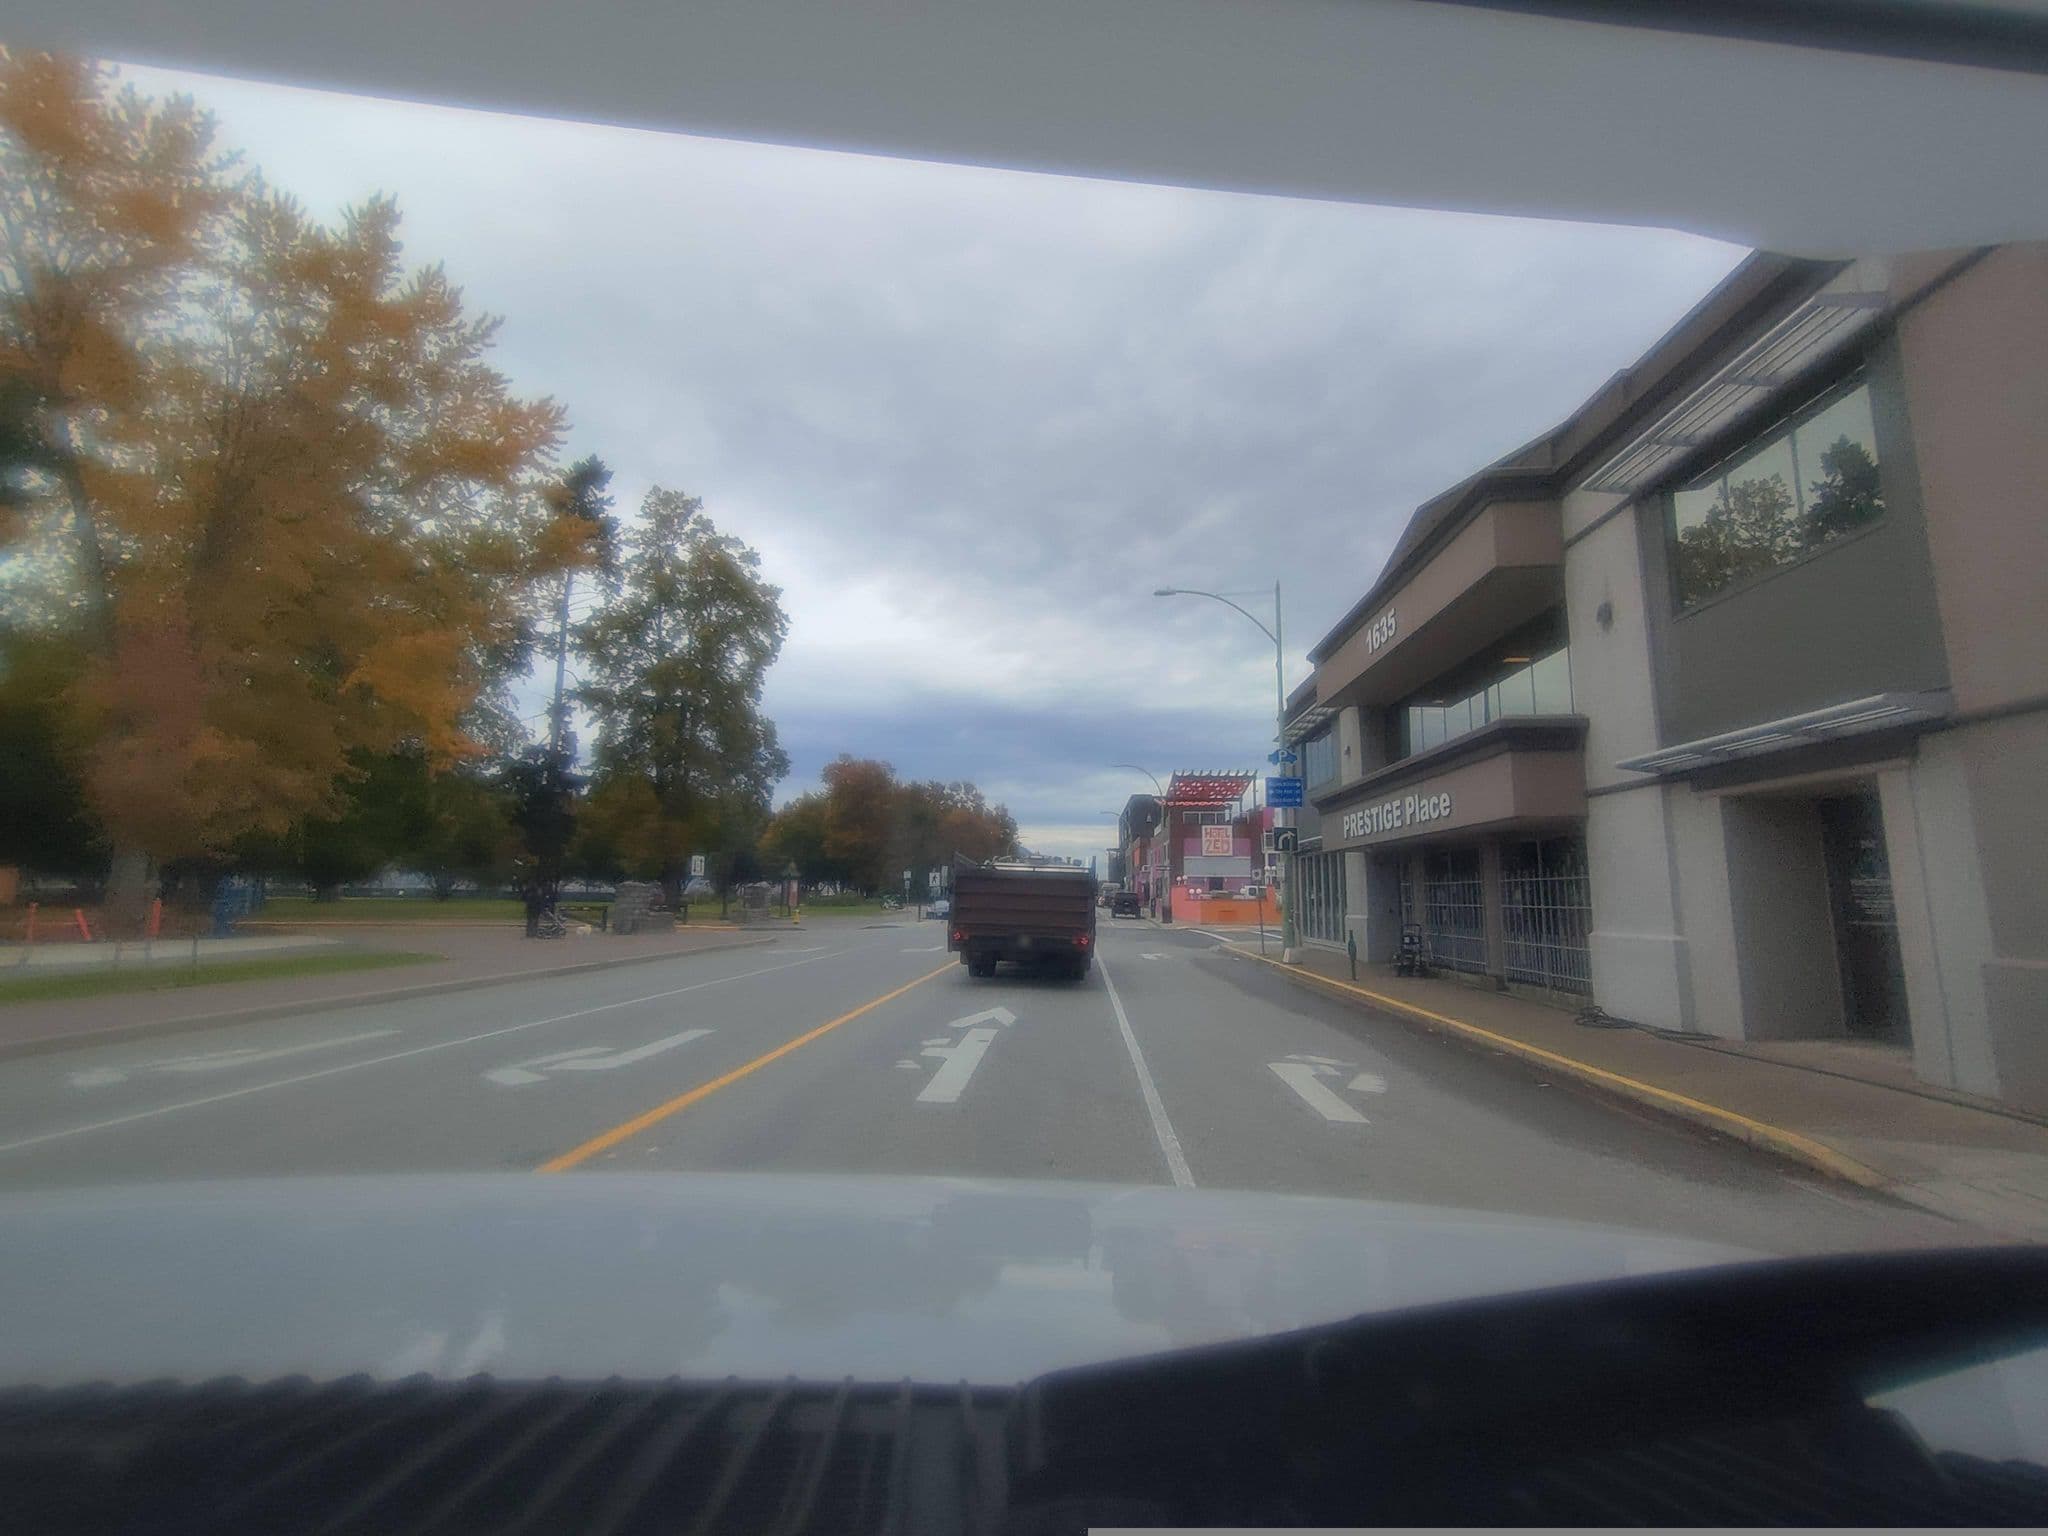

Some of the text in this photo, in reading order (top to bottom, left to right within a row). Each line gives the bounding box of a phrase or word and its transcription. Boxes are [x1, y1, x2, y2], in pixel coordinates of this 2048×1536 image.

[1365, 607, 1397, 655] 1635
[1279, 750, 1288, 763] P
[1343, 792, 1452, 839] PRESTIGE Place
[1204, 839, 1231, 851] ZED
